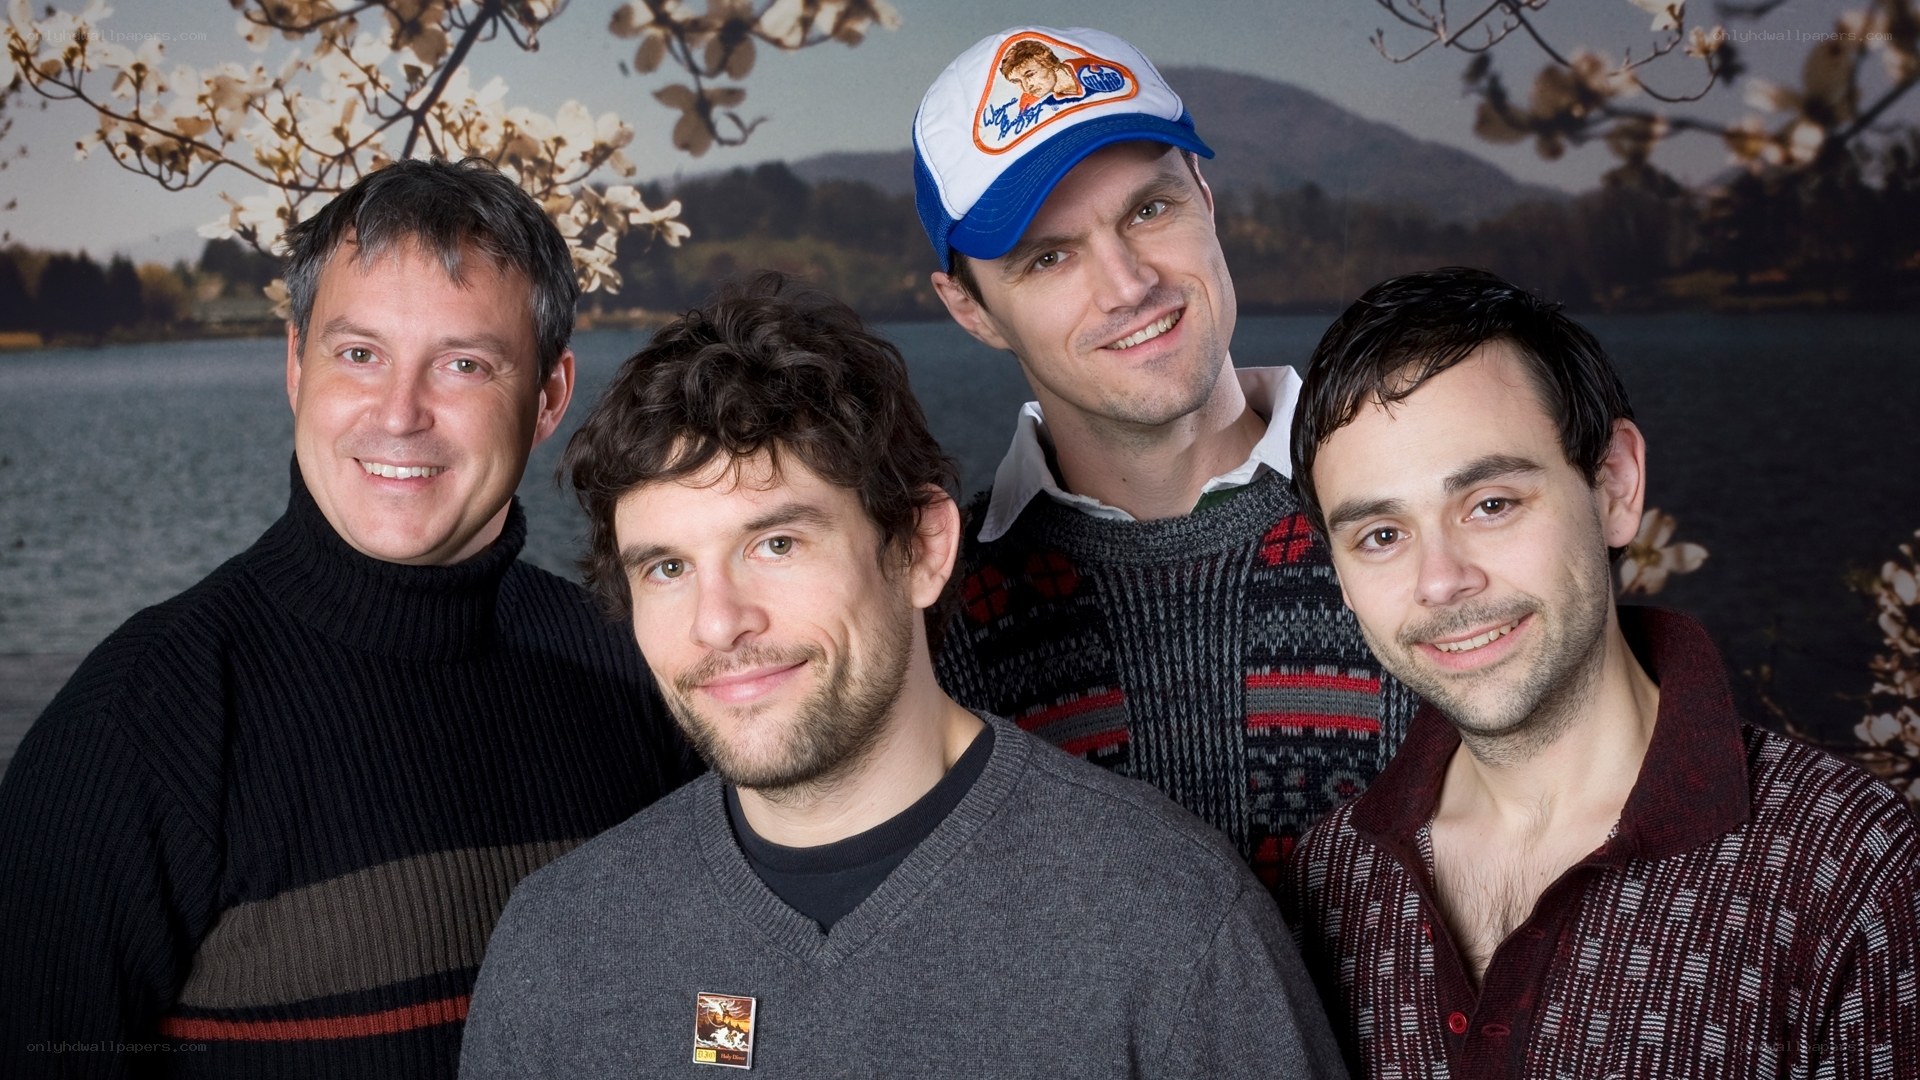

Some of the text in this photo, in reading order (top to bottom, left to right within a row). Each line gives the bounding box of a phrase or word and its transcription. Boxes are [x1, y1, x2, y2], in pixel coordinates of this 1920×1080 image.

[1082, 72, 1121, 92] OILERS
[983, 97, 1018, 127] Wayne
[720, 1053, 732, 1061] Holy
